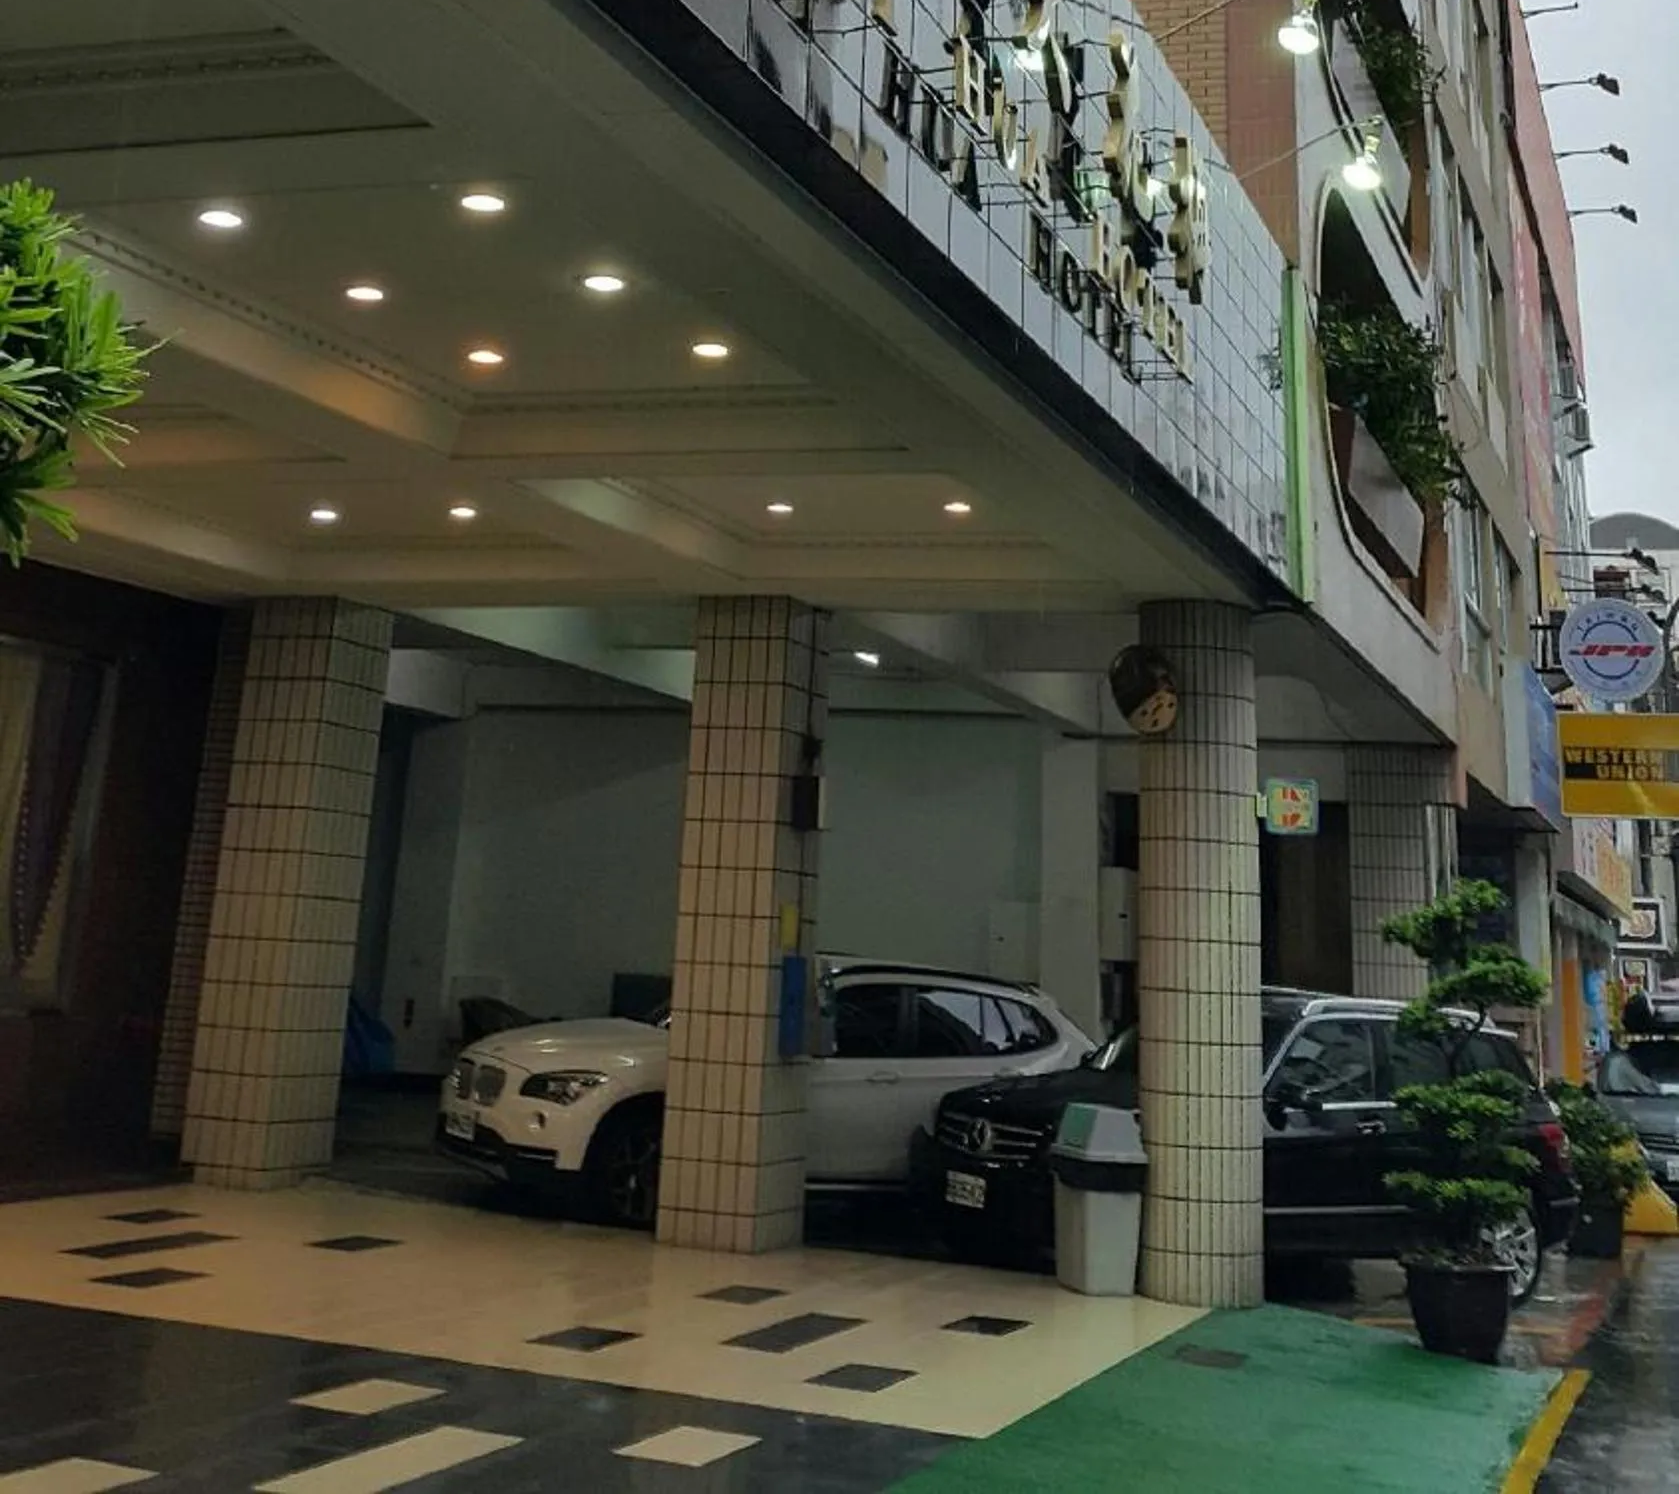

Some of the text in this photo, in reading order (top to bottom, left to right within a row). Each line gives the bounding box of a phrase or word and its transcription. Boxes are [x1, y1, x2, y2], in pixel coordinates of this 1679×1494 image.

[951, 34, 1050, 208] HUA
[1090, 209, 1195, 386] HOTEL
[1565, 748, 1663, 764] WESTERN
[1597, 764, 1664, 780] UNION
